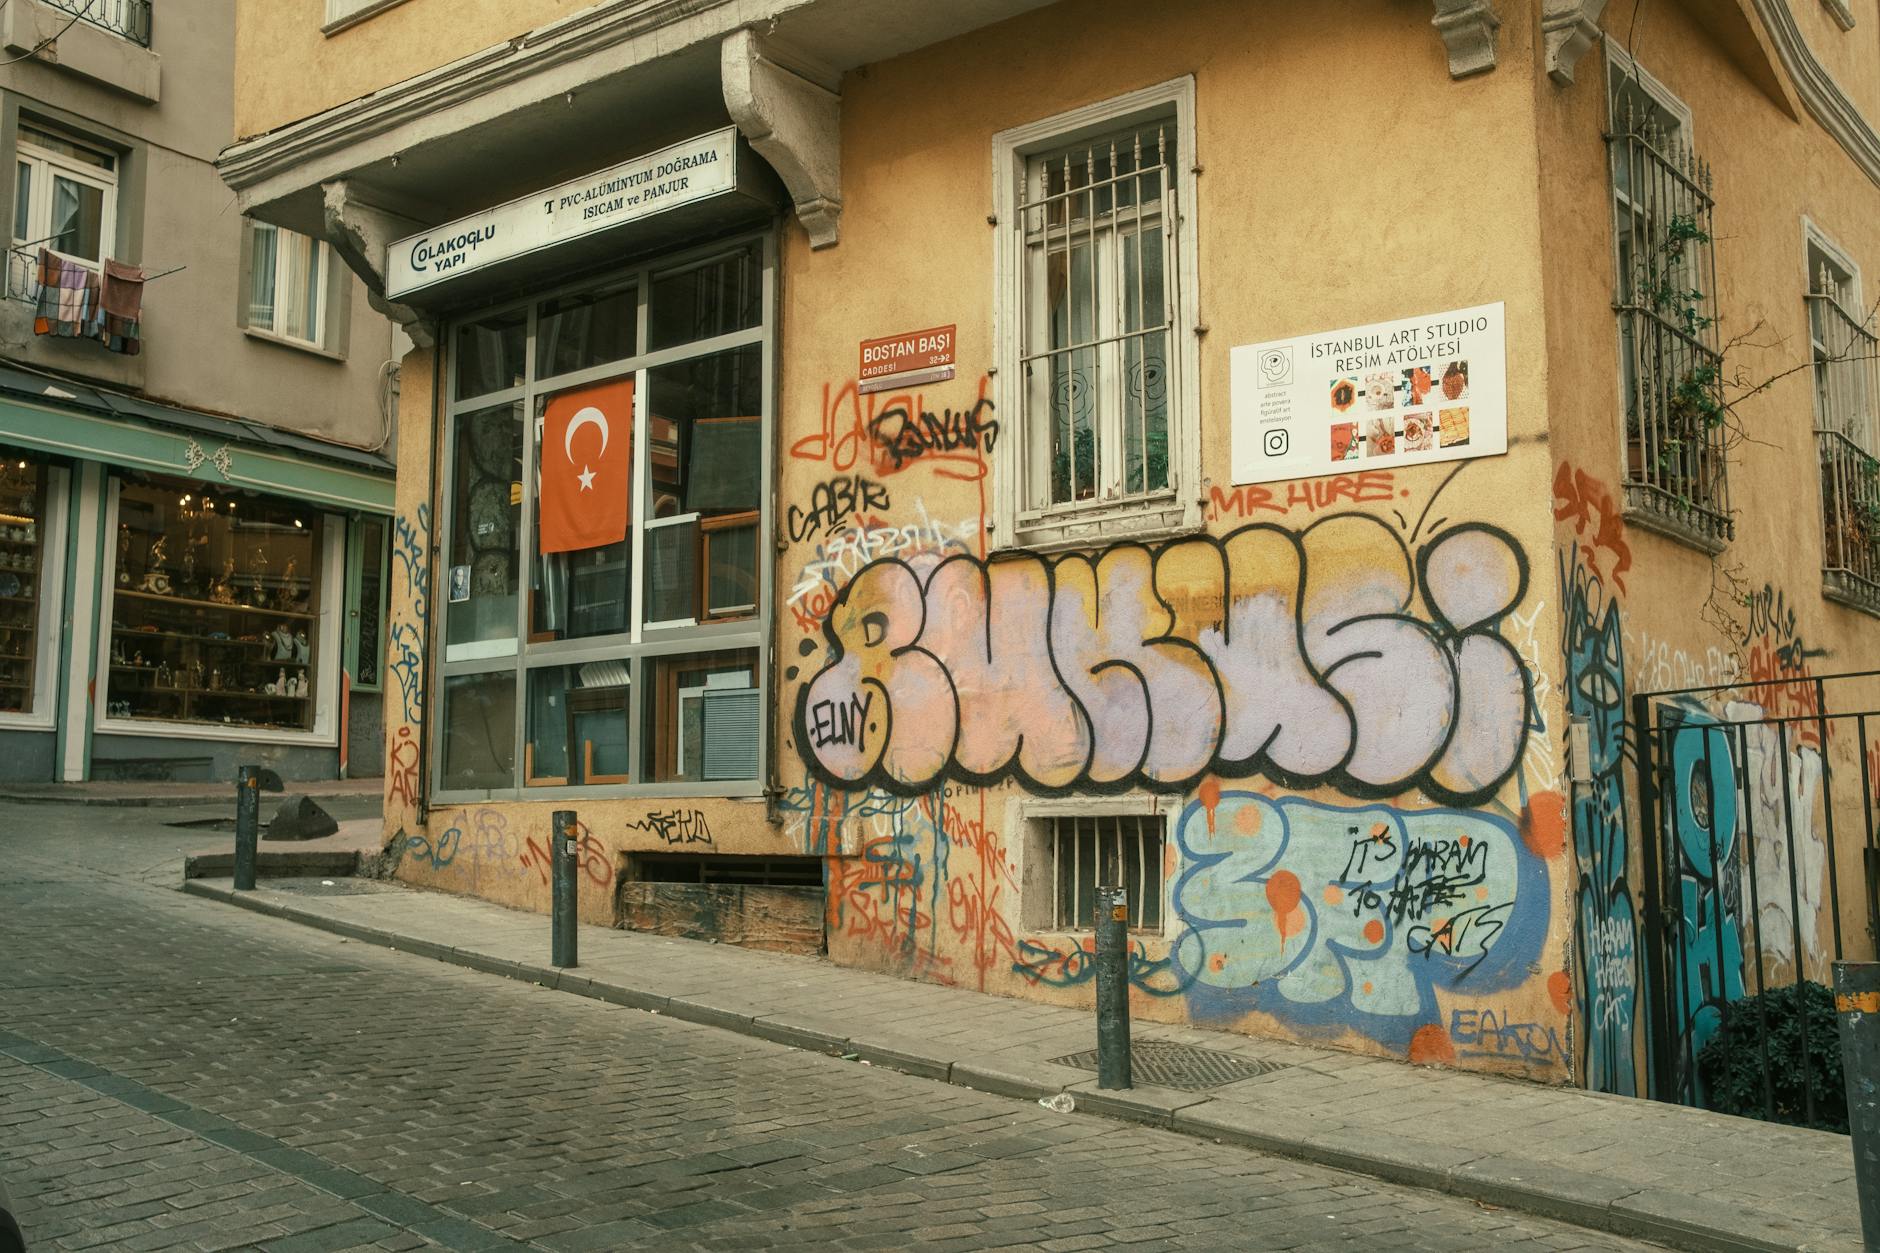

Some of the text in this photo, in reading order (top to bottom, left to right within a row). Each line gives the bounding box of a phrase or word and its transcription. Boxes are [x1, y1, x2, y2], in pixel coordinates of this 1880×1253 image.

[560, 168, 653, 210] PVC-ALÜMİNYUM
[657, 149, 718, 178] DOĞRAMA
[583, 177, 689, 220] ISICAM ve PANJUR
[435, 252, 466, 272] YAPI
[863, 333, 951, 363] BOSTAN BAŞI
[1311, 317, 1488, 359] İSTANBUL ART STUDIO
[1336, 338, 1461, 373] RESİM ATÖLYESİ
